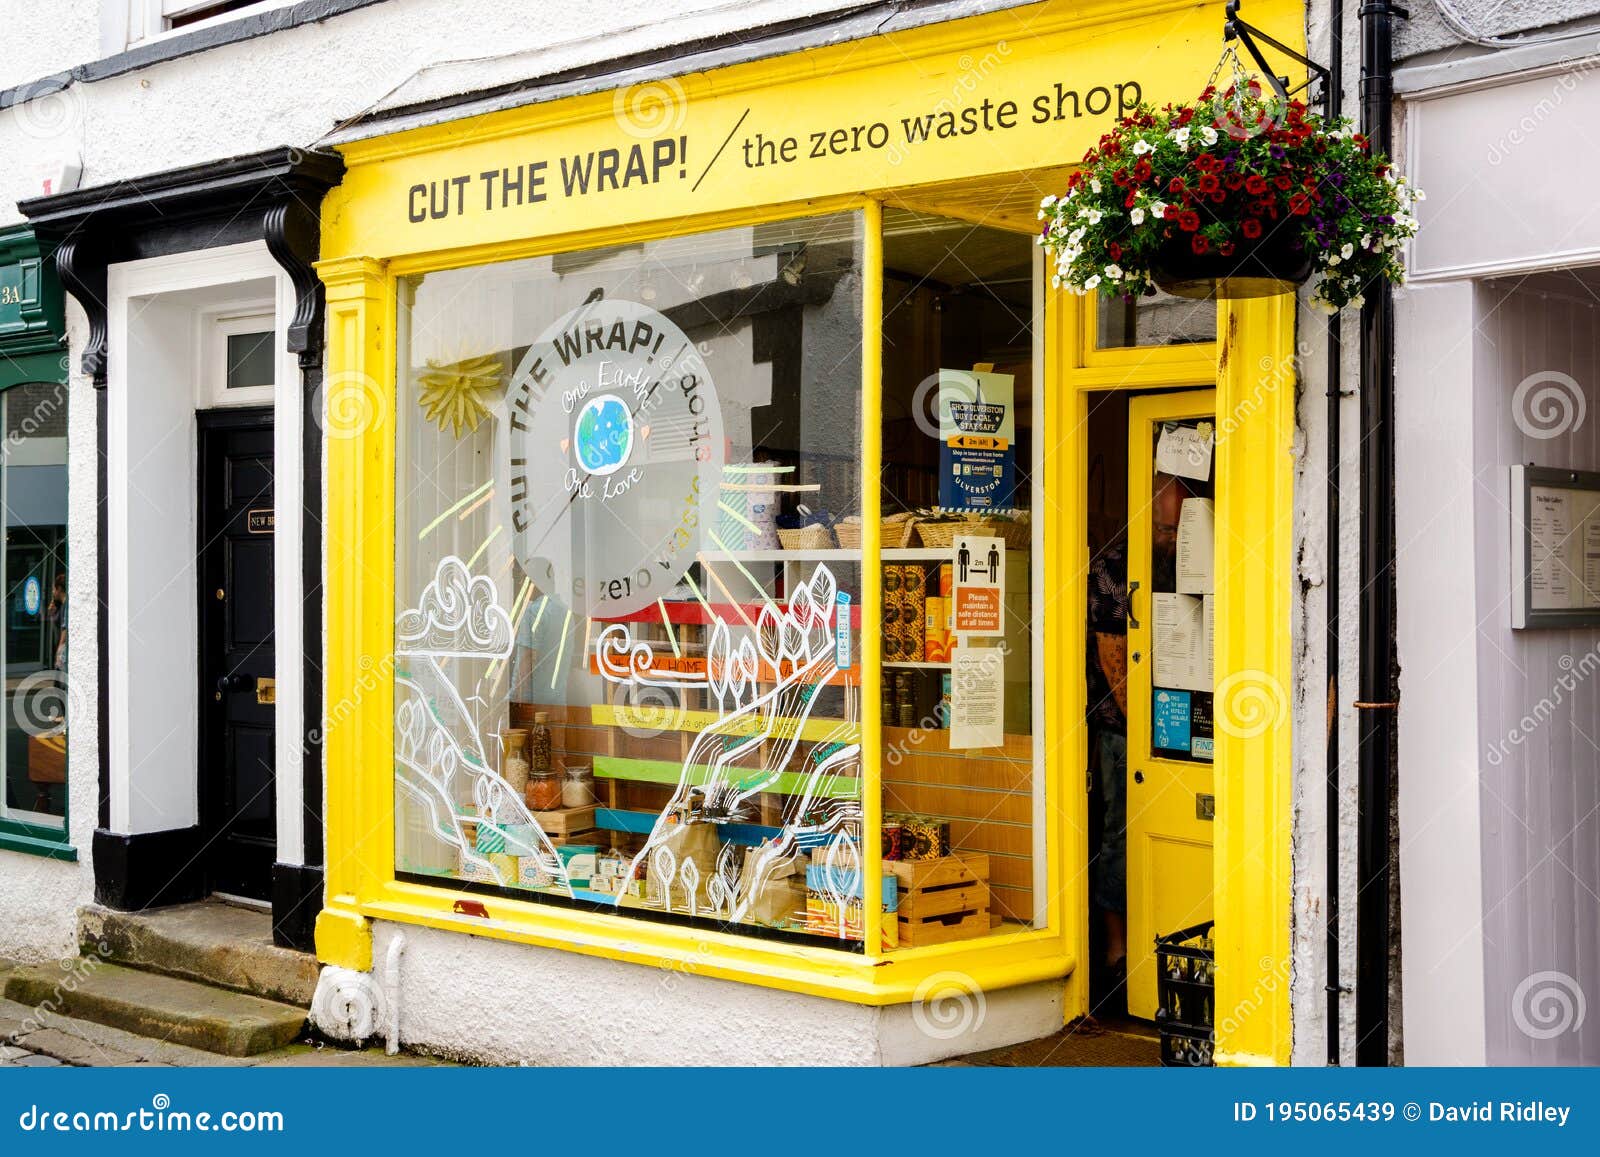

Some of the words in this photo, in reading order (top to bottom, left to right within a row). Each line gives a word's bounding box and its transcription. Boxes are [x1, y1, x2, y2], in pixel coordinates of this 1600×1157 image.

[408, 175, 471, 223] CUT
[480, 160, 548, 211] THE
[560, 135, 687, 197] WRAP!
[742, 133, 797, 168] the
[808, 122, 889, 158] zero
[901, 98, 1018, 143] waste
[1032, 80, 1142, 124] shop
[2, 285, 20, 304] 3A
[552, 316, 665, 365] WRAP!
[955, 412, 968, 421] BUY
[970, 412, 992, 422] LOCAL
[960, 422, 977, 430] STAY
[979, 423, 996, 431] SAFE
[602, 466, 645, 502] Love
[955, 476, 1001, 494] ULVERSTON
[251, 516, 266, 527] NEW
[968, 593, 989, 601] Please
[962, 602, 988, 610] maintain
[958, 610, 971, 618] safe
